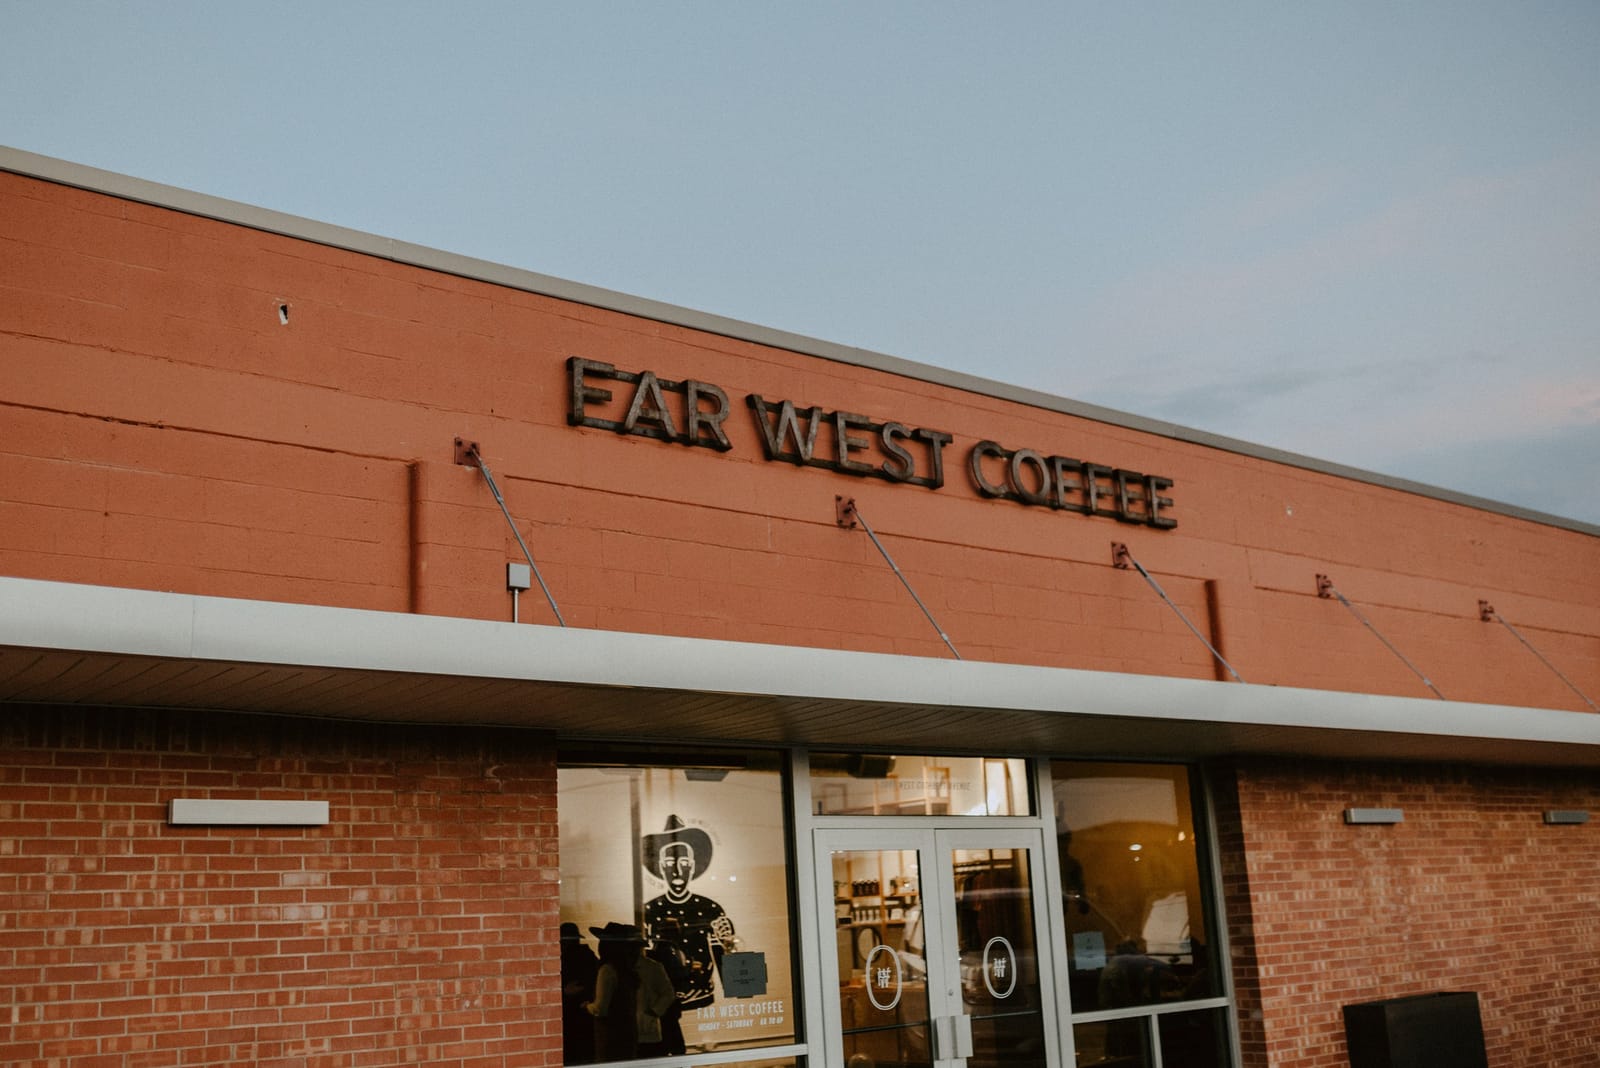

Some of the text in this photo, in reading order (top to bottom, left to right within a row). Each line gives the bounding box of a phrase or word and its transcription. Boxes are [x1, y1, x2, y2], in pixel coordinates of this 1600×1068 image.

[567, 357, 1178, 529] FAR WEST COFFEE
[697, 1001, 784, 1019] FAR WEST COFFEE
